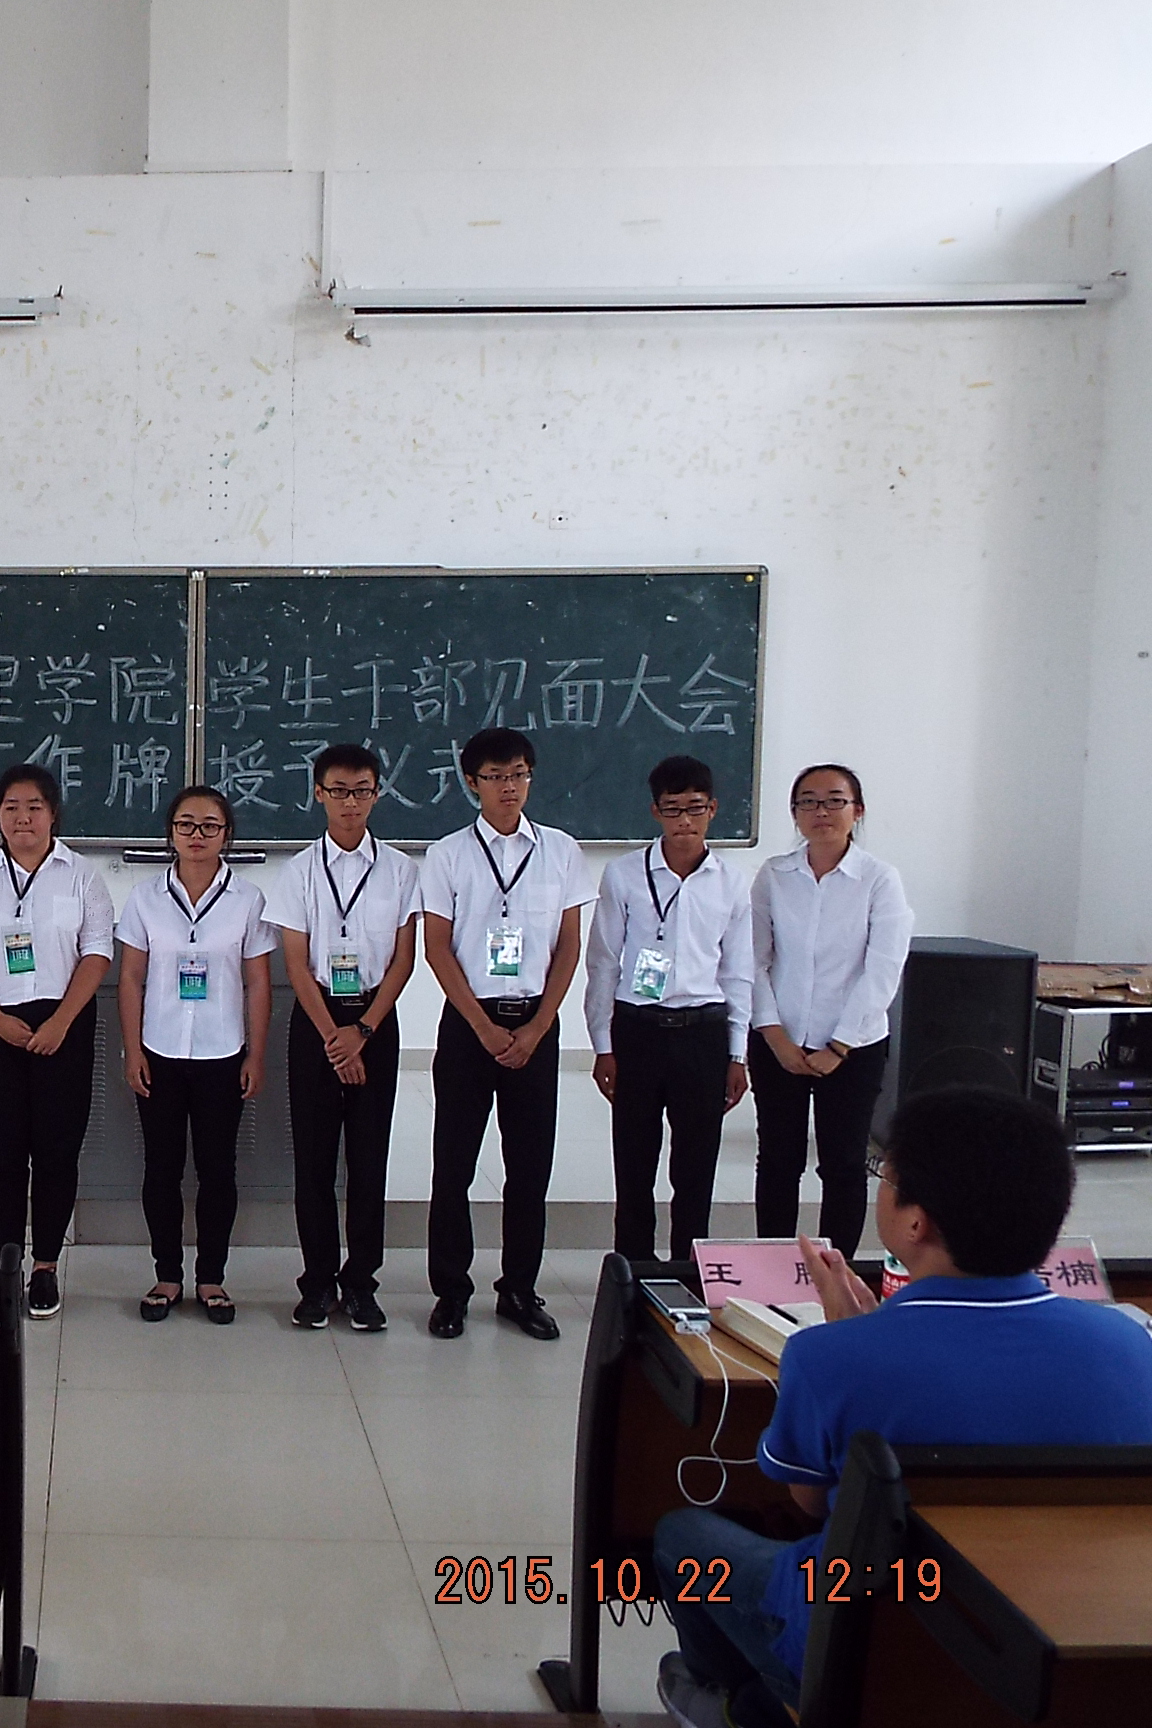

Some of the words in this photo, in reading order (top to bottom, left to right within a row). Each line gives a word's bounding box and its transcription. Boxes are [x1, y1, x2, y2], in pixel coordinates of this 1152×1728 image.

[208, 652, 748, 735] 学生干部见面大会
